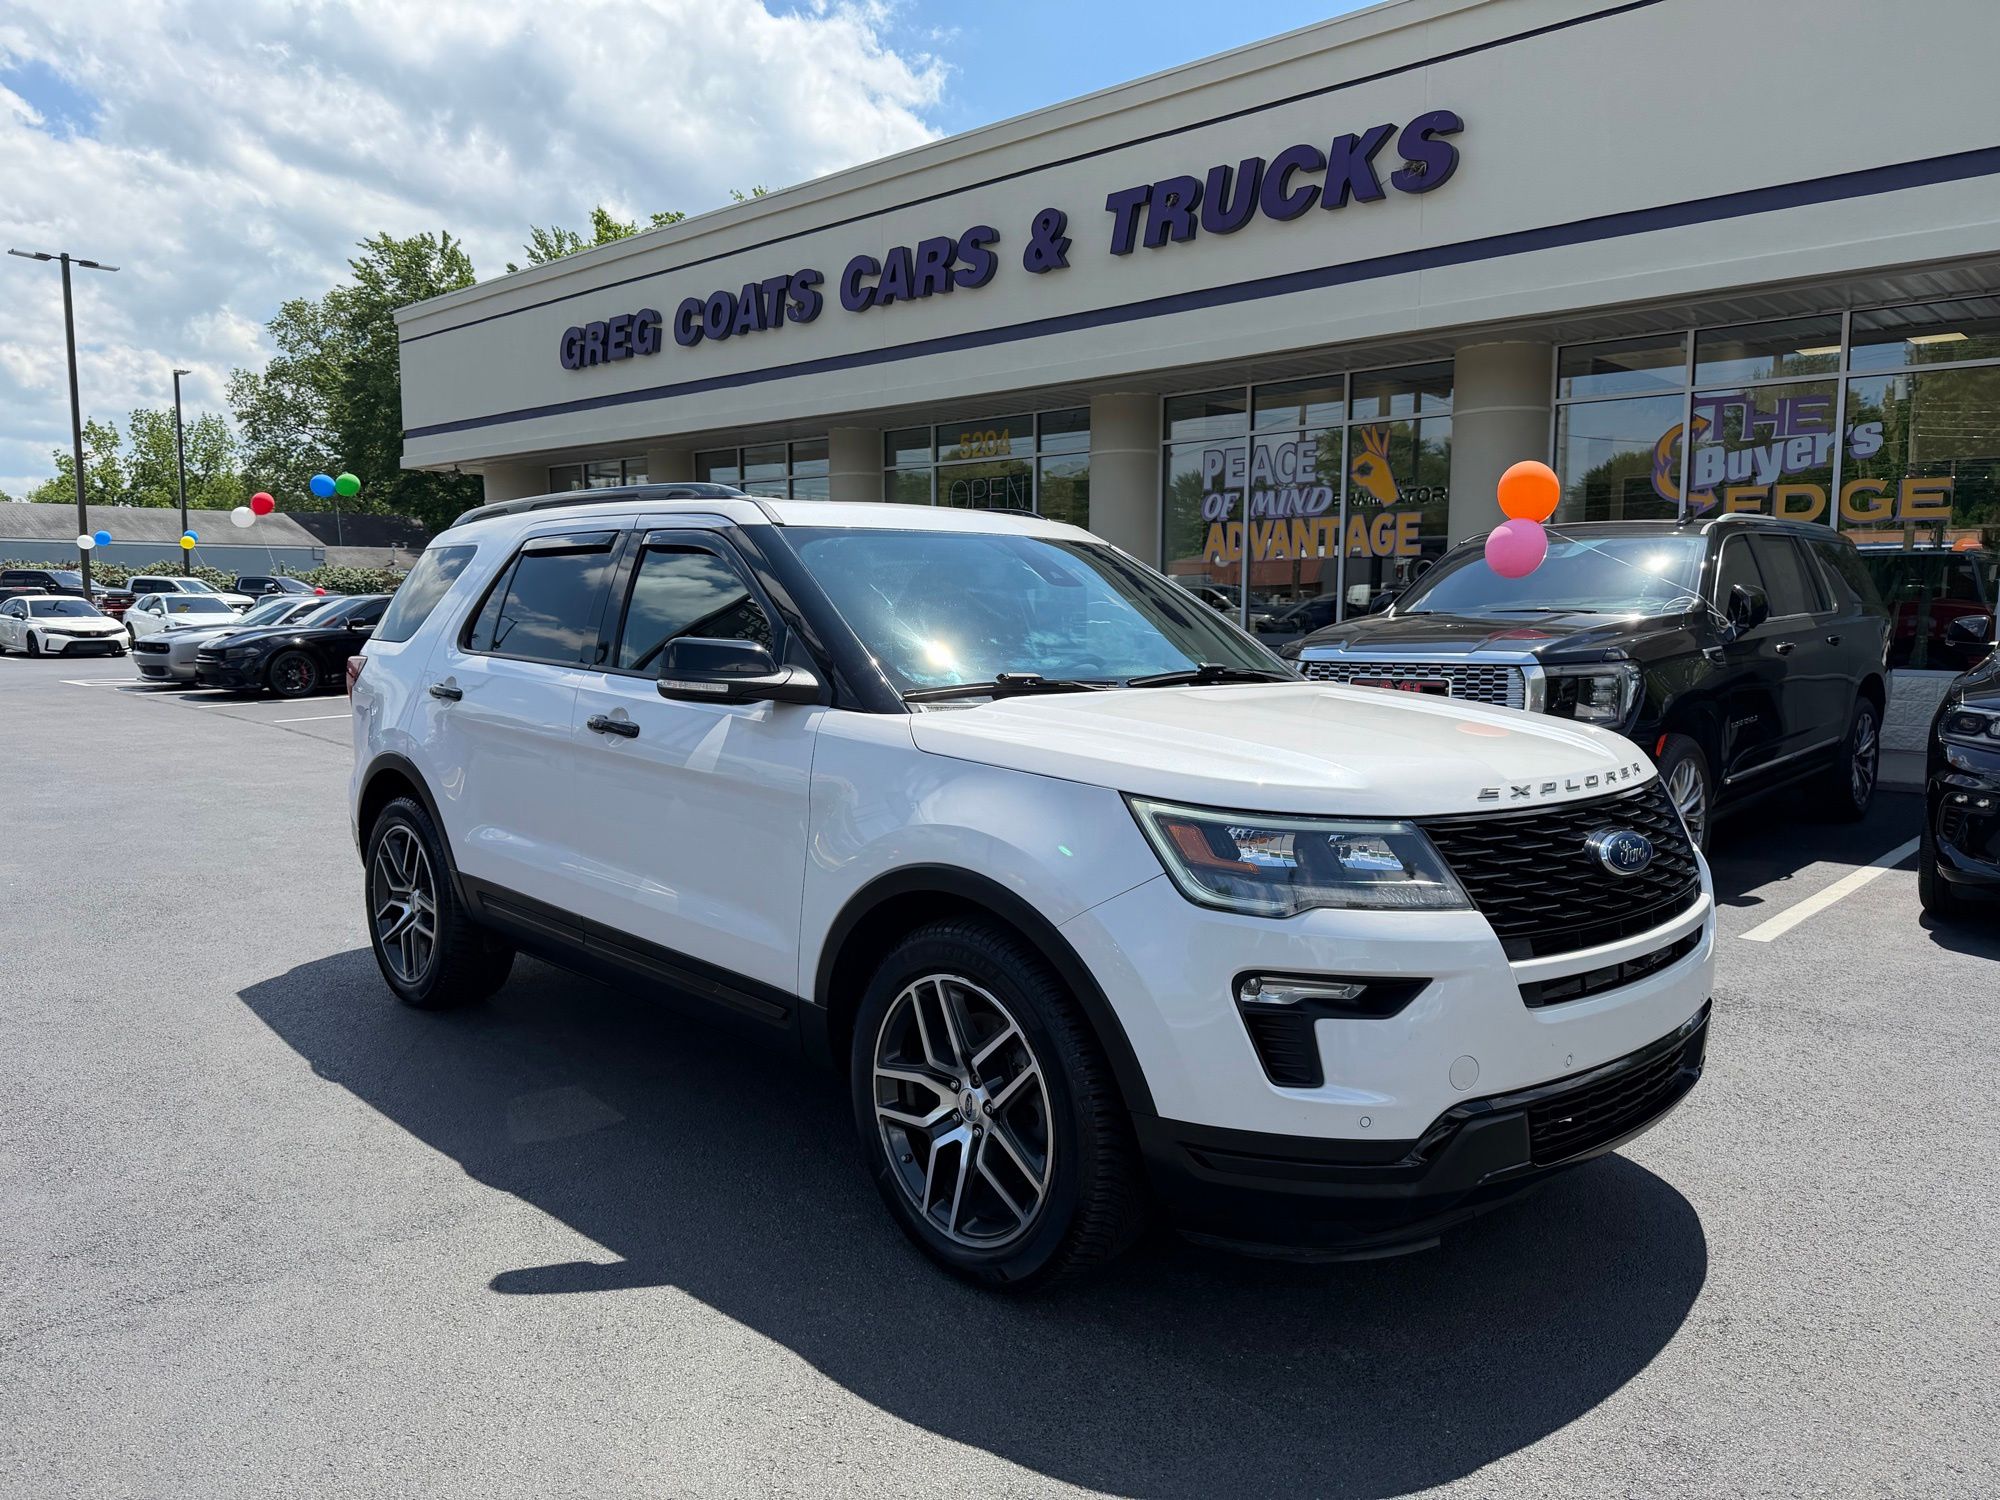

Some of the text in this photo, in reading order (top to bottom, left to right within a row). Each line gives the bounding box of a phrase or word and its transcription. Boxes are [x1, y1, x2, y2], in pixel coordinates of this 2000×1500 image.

[560, 109, 1464, 371] GREG COATS CARS & TRUCKS
[1693, 393, 1831, 443] THE
[959, 428, 1012, 459] 5204
[1202, 440, 1318, 491] PEACE
[950, 474, 1026, 509] OPEN
[1201, 486, 1335, 522] OF MIND
[1724, 477, 1954, 523] EDGE
[1202, 512, 1423, 562] ADVANTAGE
[1477, 762, 1641, 800] EXPLORER
